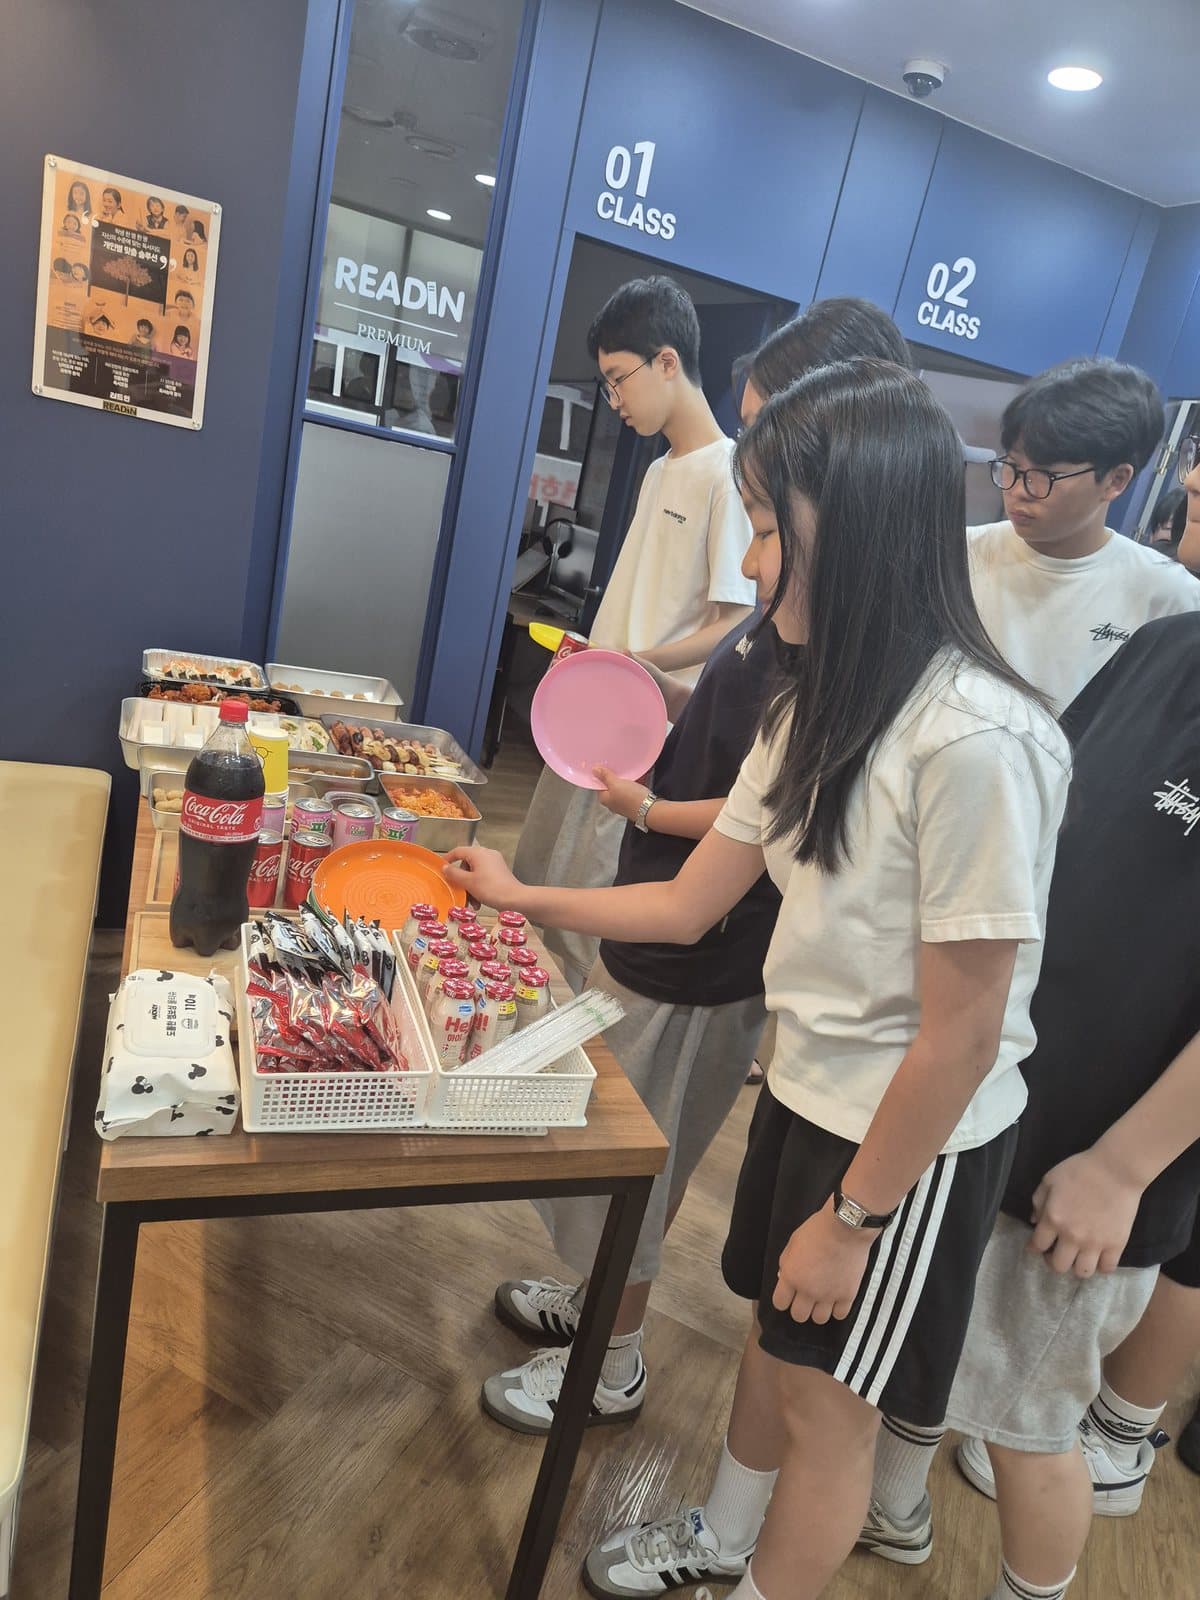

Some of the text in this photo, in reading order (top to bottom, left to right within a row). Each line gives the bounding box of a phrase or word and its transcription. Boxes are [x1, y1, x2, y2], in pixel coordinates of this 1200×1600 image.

[605, 141, 656, 198] 01
[597, 191, 677, 240] CLASS
[103, 240, 158, 263] 개인별 맞춤 솔루션
[926, 257, 977, 309] 02
[357, 322, 432, 355] PREMIUM
[917, 301, 981, 340] CLASS
[185, 796, 249, 826] Coca-Cola
